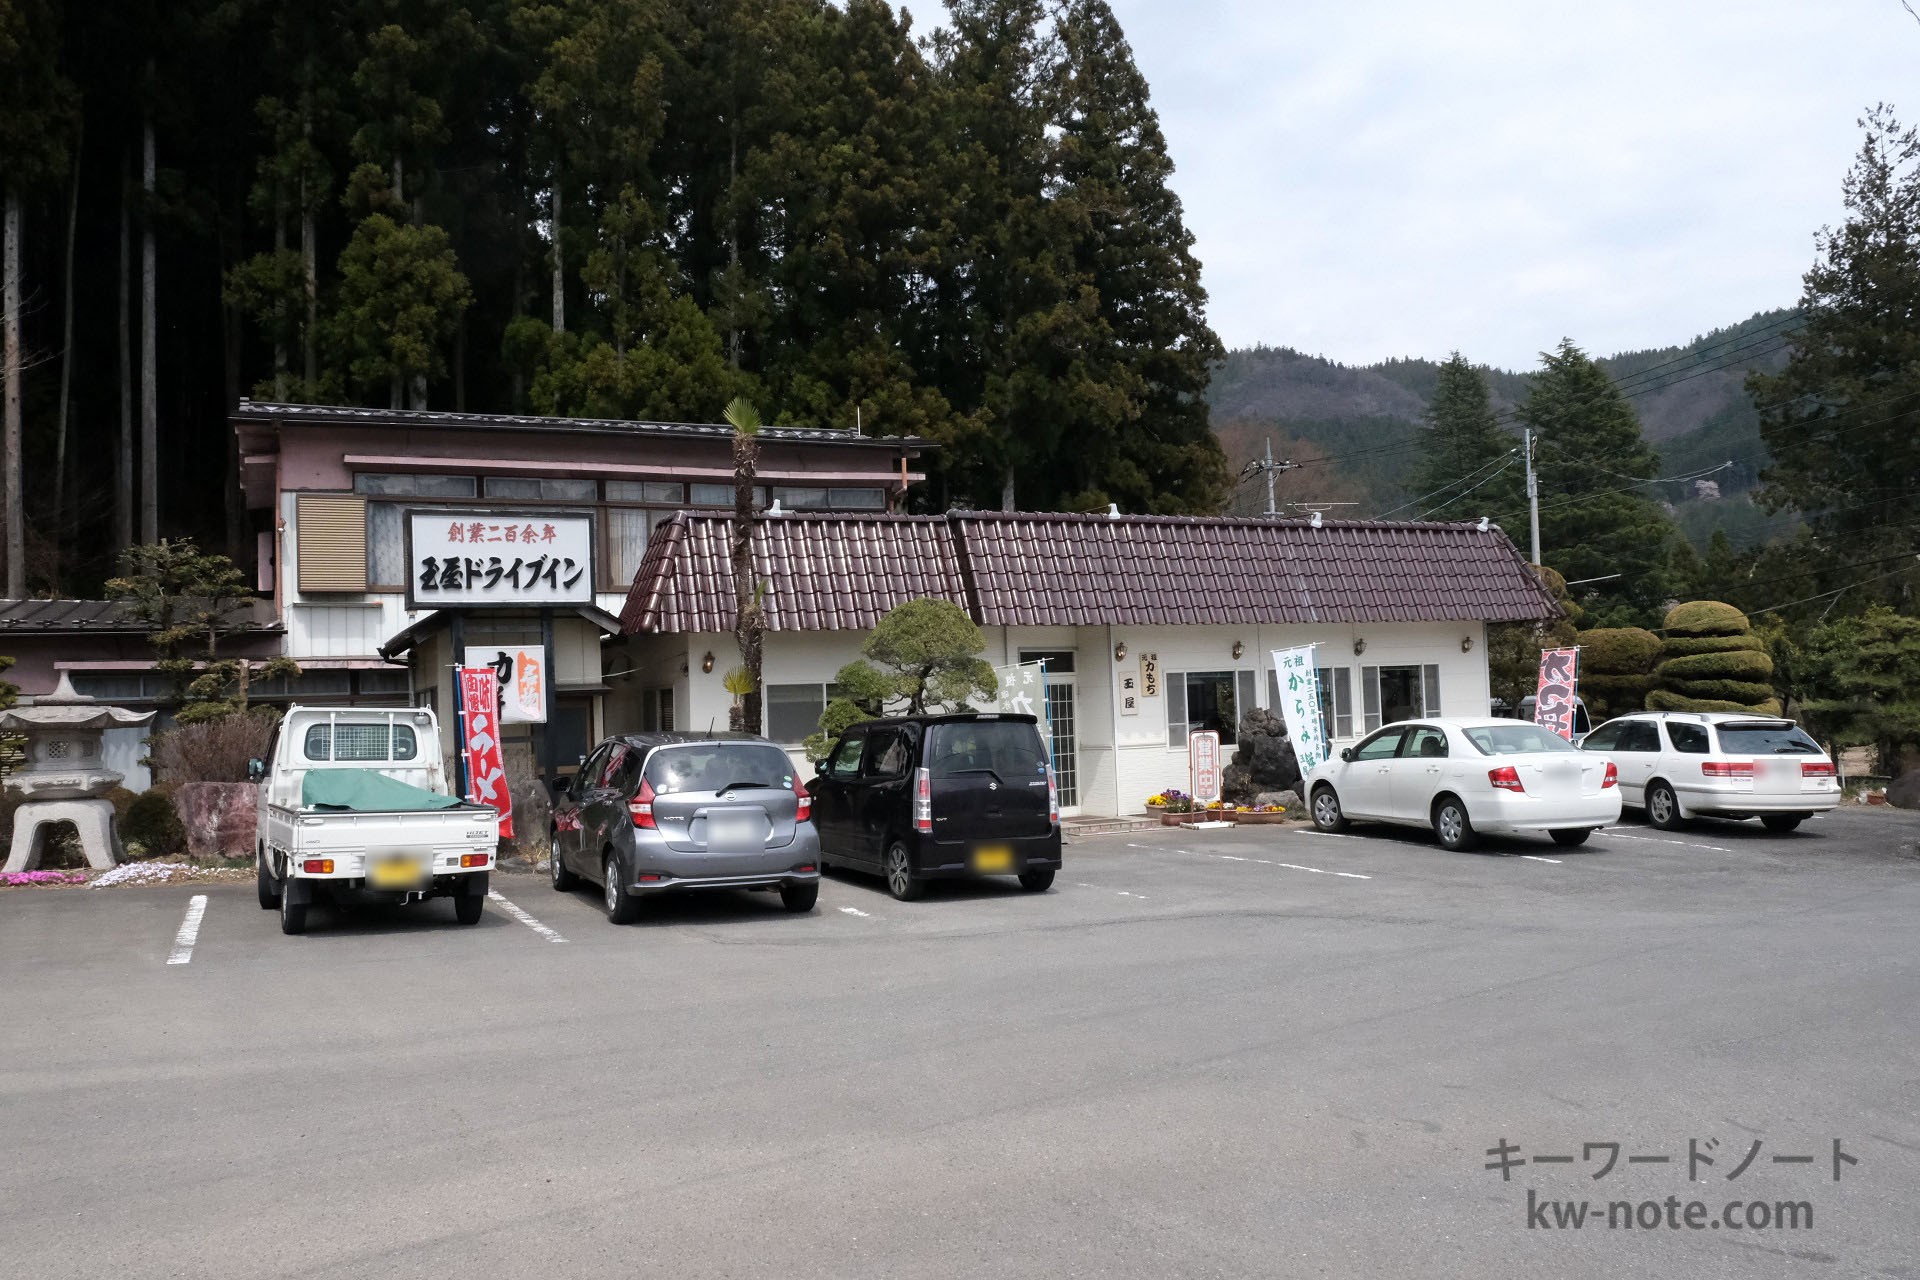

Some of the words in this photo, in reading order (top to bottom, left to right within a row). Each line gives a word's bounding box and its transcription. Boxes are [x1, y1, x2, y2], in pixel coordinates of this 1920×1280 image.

[447, 522, 557, 544] 創業二百余年
[419, 553, 584, 590] 玉屋ドライブイン
[1145, 660, 1156, 695] 力もち
[1282, 655, 1305, 669] 元祖
[1123, 678, 1135, 709] 玉屋
[470, 713, 502, 805] ラーメ
[1198, 741, 1213, 788] 営業中
